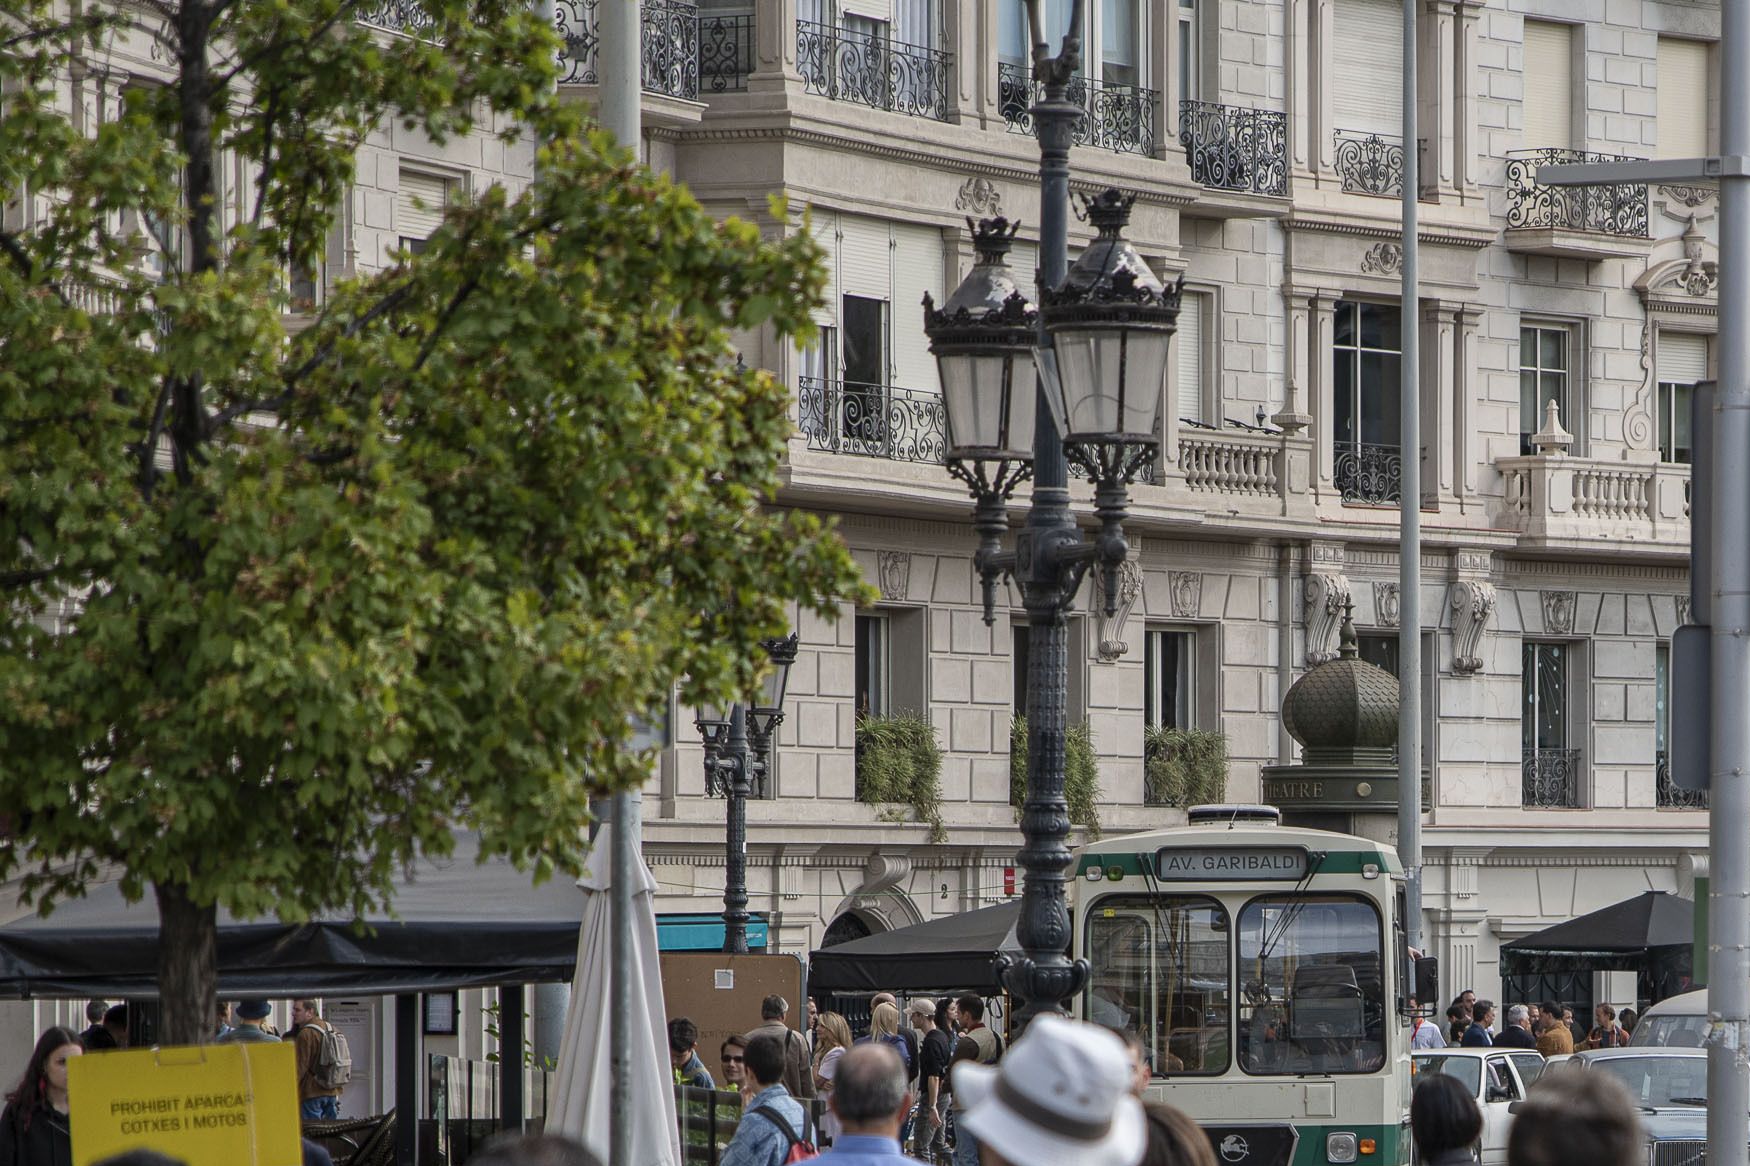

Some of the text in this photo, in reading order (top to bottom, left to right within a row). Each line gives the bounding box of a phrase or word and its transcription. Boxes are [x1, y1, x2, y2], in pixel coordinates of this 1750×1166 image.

[1168, 855, 1300, 871] AV. GARIBALDI
[110, 1098, 181, 1117] PROHIBIT
[120, 1112, 248, 1135] COTXES I MOTOS
